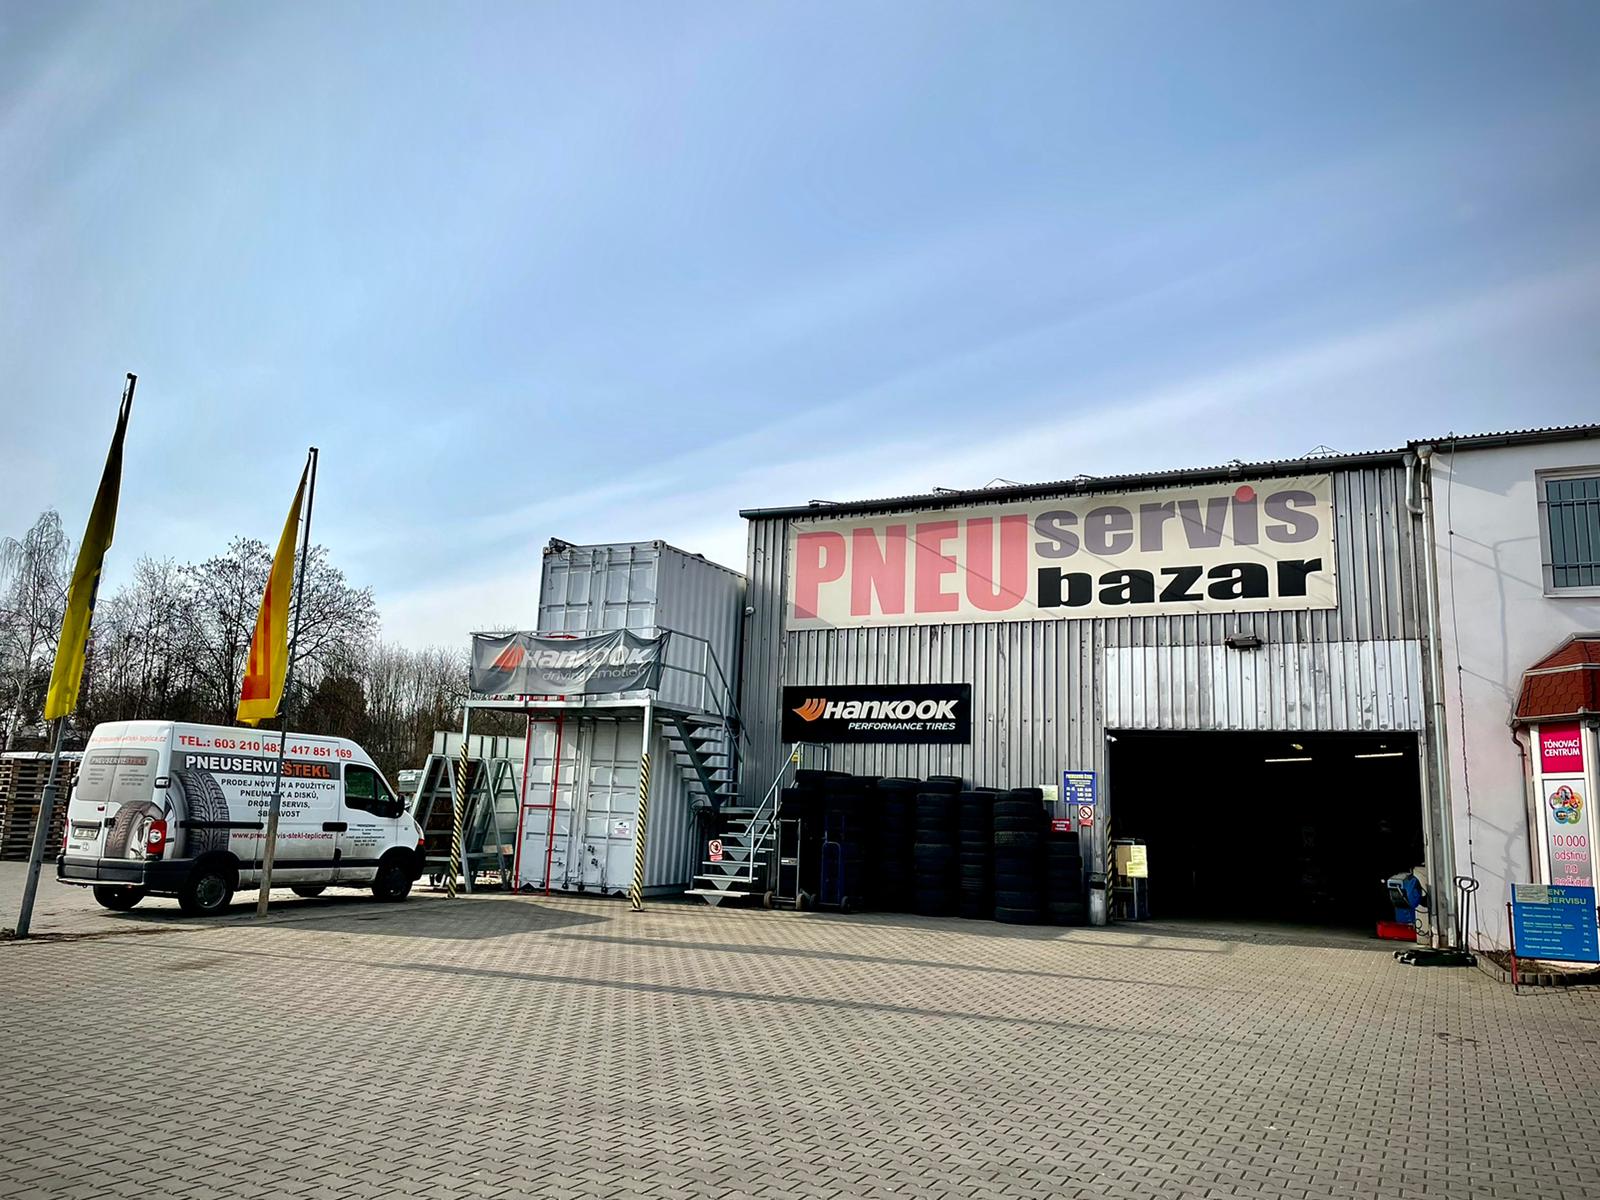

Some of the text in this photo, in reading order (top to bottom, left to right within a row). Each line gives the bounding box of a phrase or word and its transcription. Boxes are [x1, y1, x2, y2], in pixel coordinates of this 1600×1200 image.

[794, 485, 1320, 619] PNEU servis
[1037, 557, 1323, 608] bazar
[848, 722, 956, 731] PERFORMANCE TIRES
[179, 735, 211, 747] TEL.:
[214, 738, 236, 749] 603
[239, 740, 260, 751] 210
[291, 745, 310, 755] 417
[313, 747, 331, 757] 851
[334, 749, 352, 759] 169
[1544, 748, 1581, 757] CENTRUM
[221, 778, 253, 788] PRODEJ
[255, 779, 288, 789] NOVÝH
[295, 781, 336, 790] POUŽITÝCH
[281, 801, 310, 809] SERVIS,
[1553, 834, 1586, 848] 10 000
